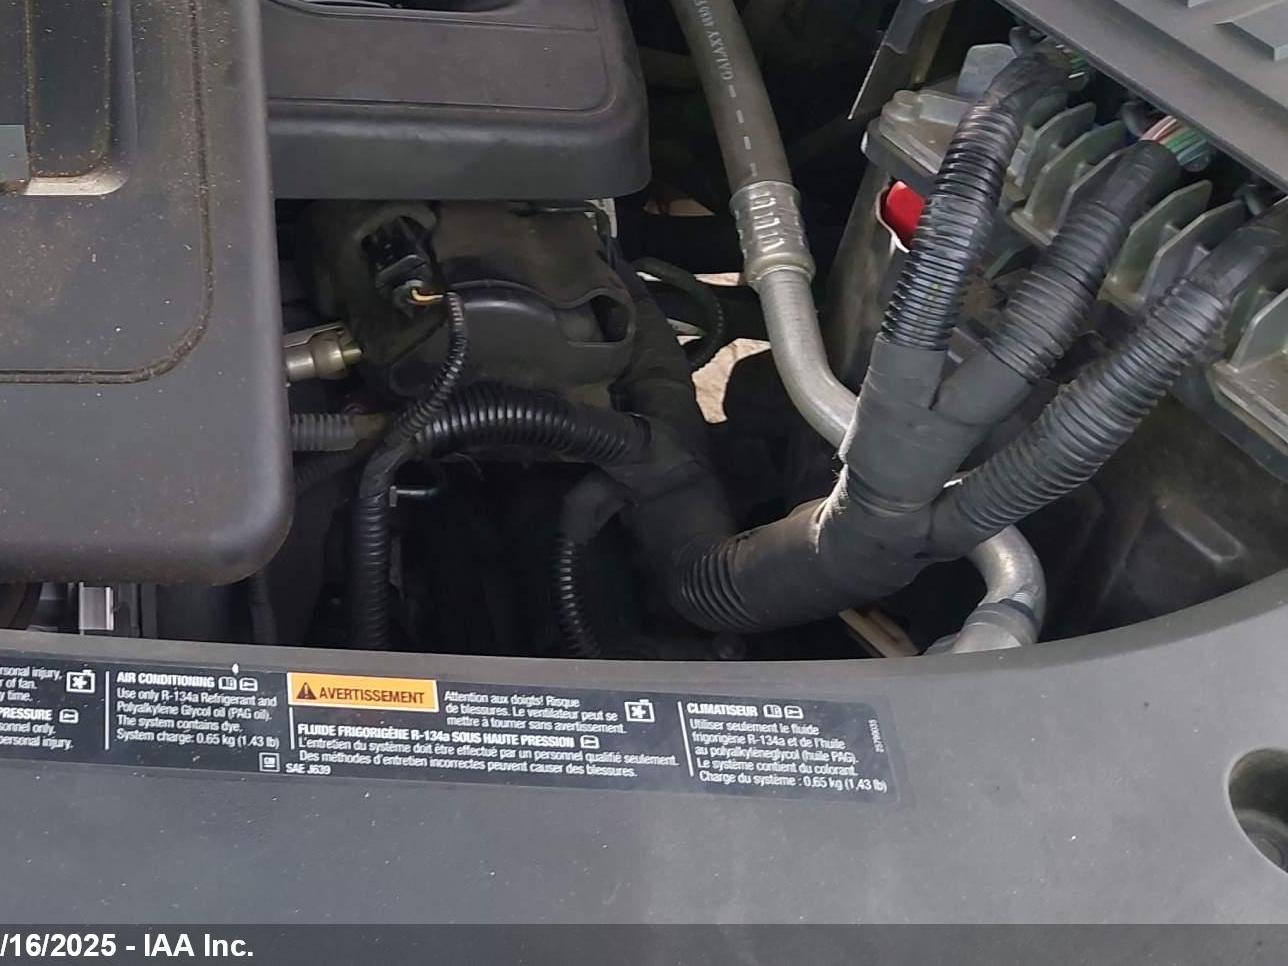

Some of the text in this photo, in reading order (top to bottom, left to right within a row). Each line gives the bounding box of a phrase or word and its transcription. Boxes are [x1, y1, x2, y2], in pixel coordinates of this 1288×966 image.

[6, 677, 16, 688] of
[18, 678, 37, 690] fan.
[116, 671, 215, 689] AIR CONDITIONING
[7, 690, 33, 702] time.
[117, 687, 277, 707] Use only R-134a Refrigerant and
[319, 686, 425, 704] AVERTISSEMENT
[444, 691, 488, 704] Attention
[490, 695, 508, 704] aux
[546, 696, 580, 709] Risque
[180, 705, 211, 719] Glycol
[213, 706, 226, 718] oil
[228, 707, 251, 720] (PAG
[446, 703, 618, 722] de blessures. Le ventilateur peut se
[687, 702, 758, 717] CLIMATISEUR
[32, 723, 56, 736] only.
[117, 714, 136, 726] The
[138, 716, 174, 729] system
[176, 718, 219, 731] contains
[446, 715, 480, 727] mettre
[490, 717, 526, 729] tourner
[529, 721, 552, 730] sans
[554, 720, 627, 734] avertissement.
[690, 718, 820, 736] Utiliser seulement le fluide
[42, 736, 73, 751] injury.
[116, 728, 279, 749] System charge: 0.65 kg (1.43 lb)
[298, 723, 575, 748] FLUIDE FRIGORIGÈNE R-134a SOUS HAUTE PRESSION
[692, 731, 745, 746] frigorigène
[747, 734, 785, 746] R-134a
[787, 737, 797, 747] et
[799, 737, 812, 747] de
[298, 736, 679, 766] L'entretien du système doit être effectué par un personnel qualifié seulement.
[695, 746, 708, 755] au
[801, 750, 829, 763] (huile
[286, 763, 305, 773] SAE
[300, 750, 638, 777] Des méthodes d'entretien incorrectes peuvent causer des blessures.
[697, 758, 710, 768] Le
[712, 759, 754, 772] système
[756, 761, 796, 773] contient
[798, 763, 812, 774] du
[700, 770, 736, 784] Charge
[738, 773, 751, 783] du
[754, 774, 796, 788] système
[828, 778, 842, 790] kg
[873, 781, 887, 793] lb)
